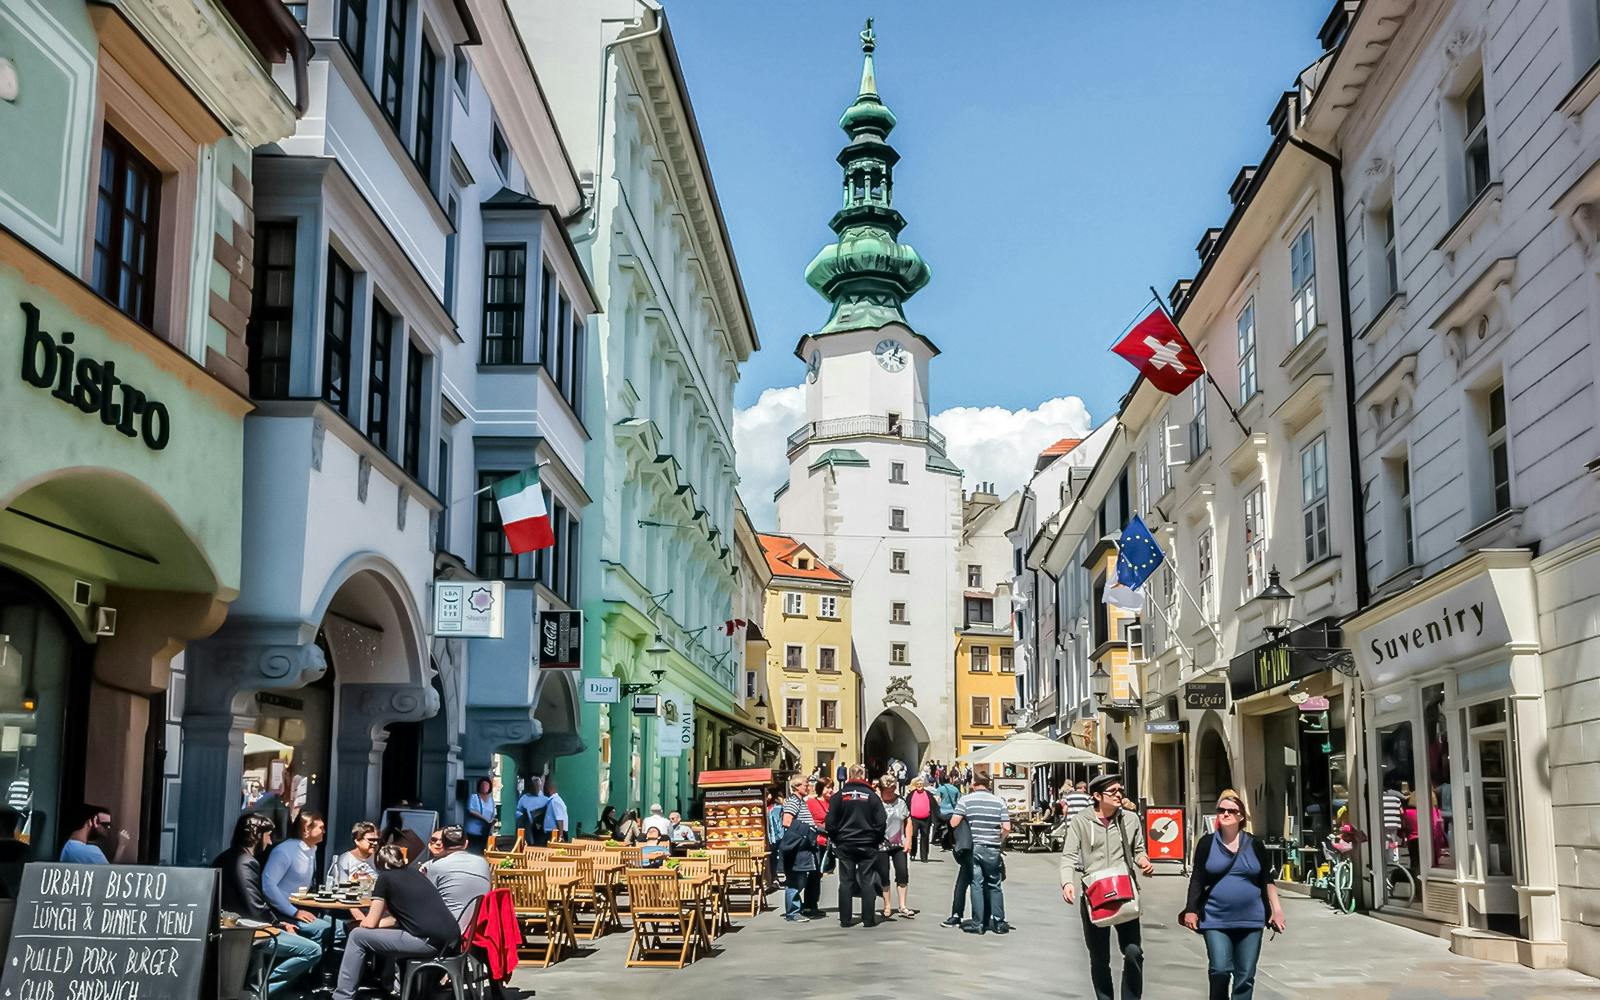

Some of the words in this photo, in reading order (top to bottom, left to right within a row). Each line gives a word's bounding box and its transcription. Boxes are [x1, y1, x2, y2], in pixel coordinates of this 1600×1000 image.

[20, 302, 170, 450] bistro
[590, 683, 613, 693] Dior
[1188, 693, 1225, 707] Cigár
[681, 712, 691, 744] IVKO
[40, 868, 94, 897] URBAN
[105, 871, 167, 900] BISTRO
[32, 905, 76, 932] LUNCH
[83, 905, 95, 931] &
[101, 908, 147, 935] DINNER
[156, 910, 193, 935] MENU
[22, 944, 73, 973] PULLED
[80, 946, 118, 975] PORK
[125, 946, 178, 977] BURGER
[19, 979, 55, 1000] CLUB
[66, 979, 140, 1000] SANDWICH
